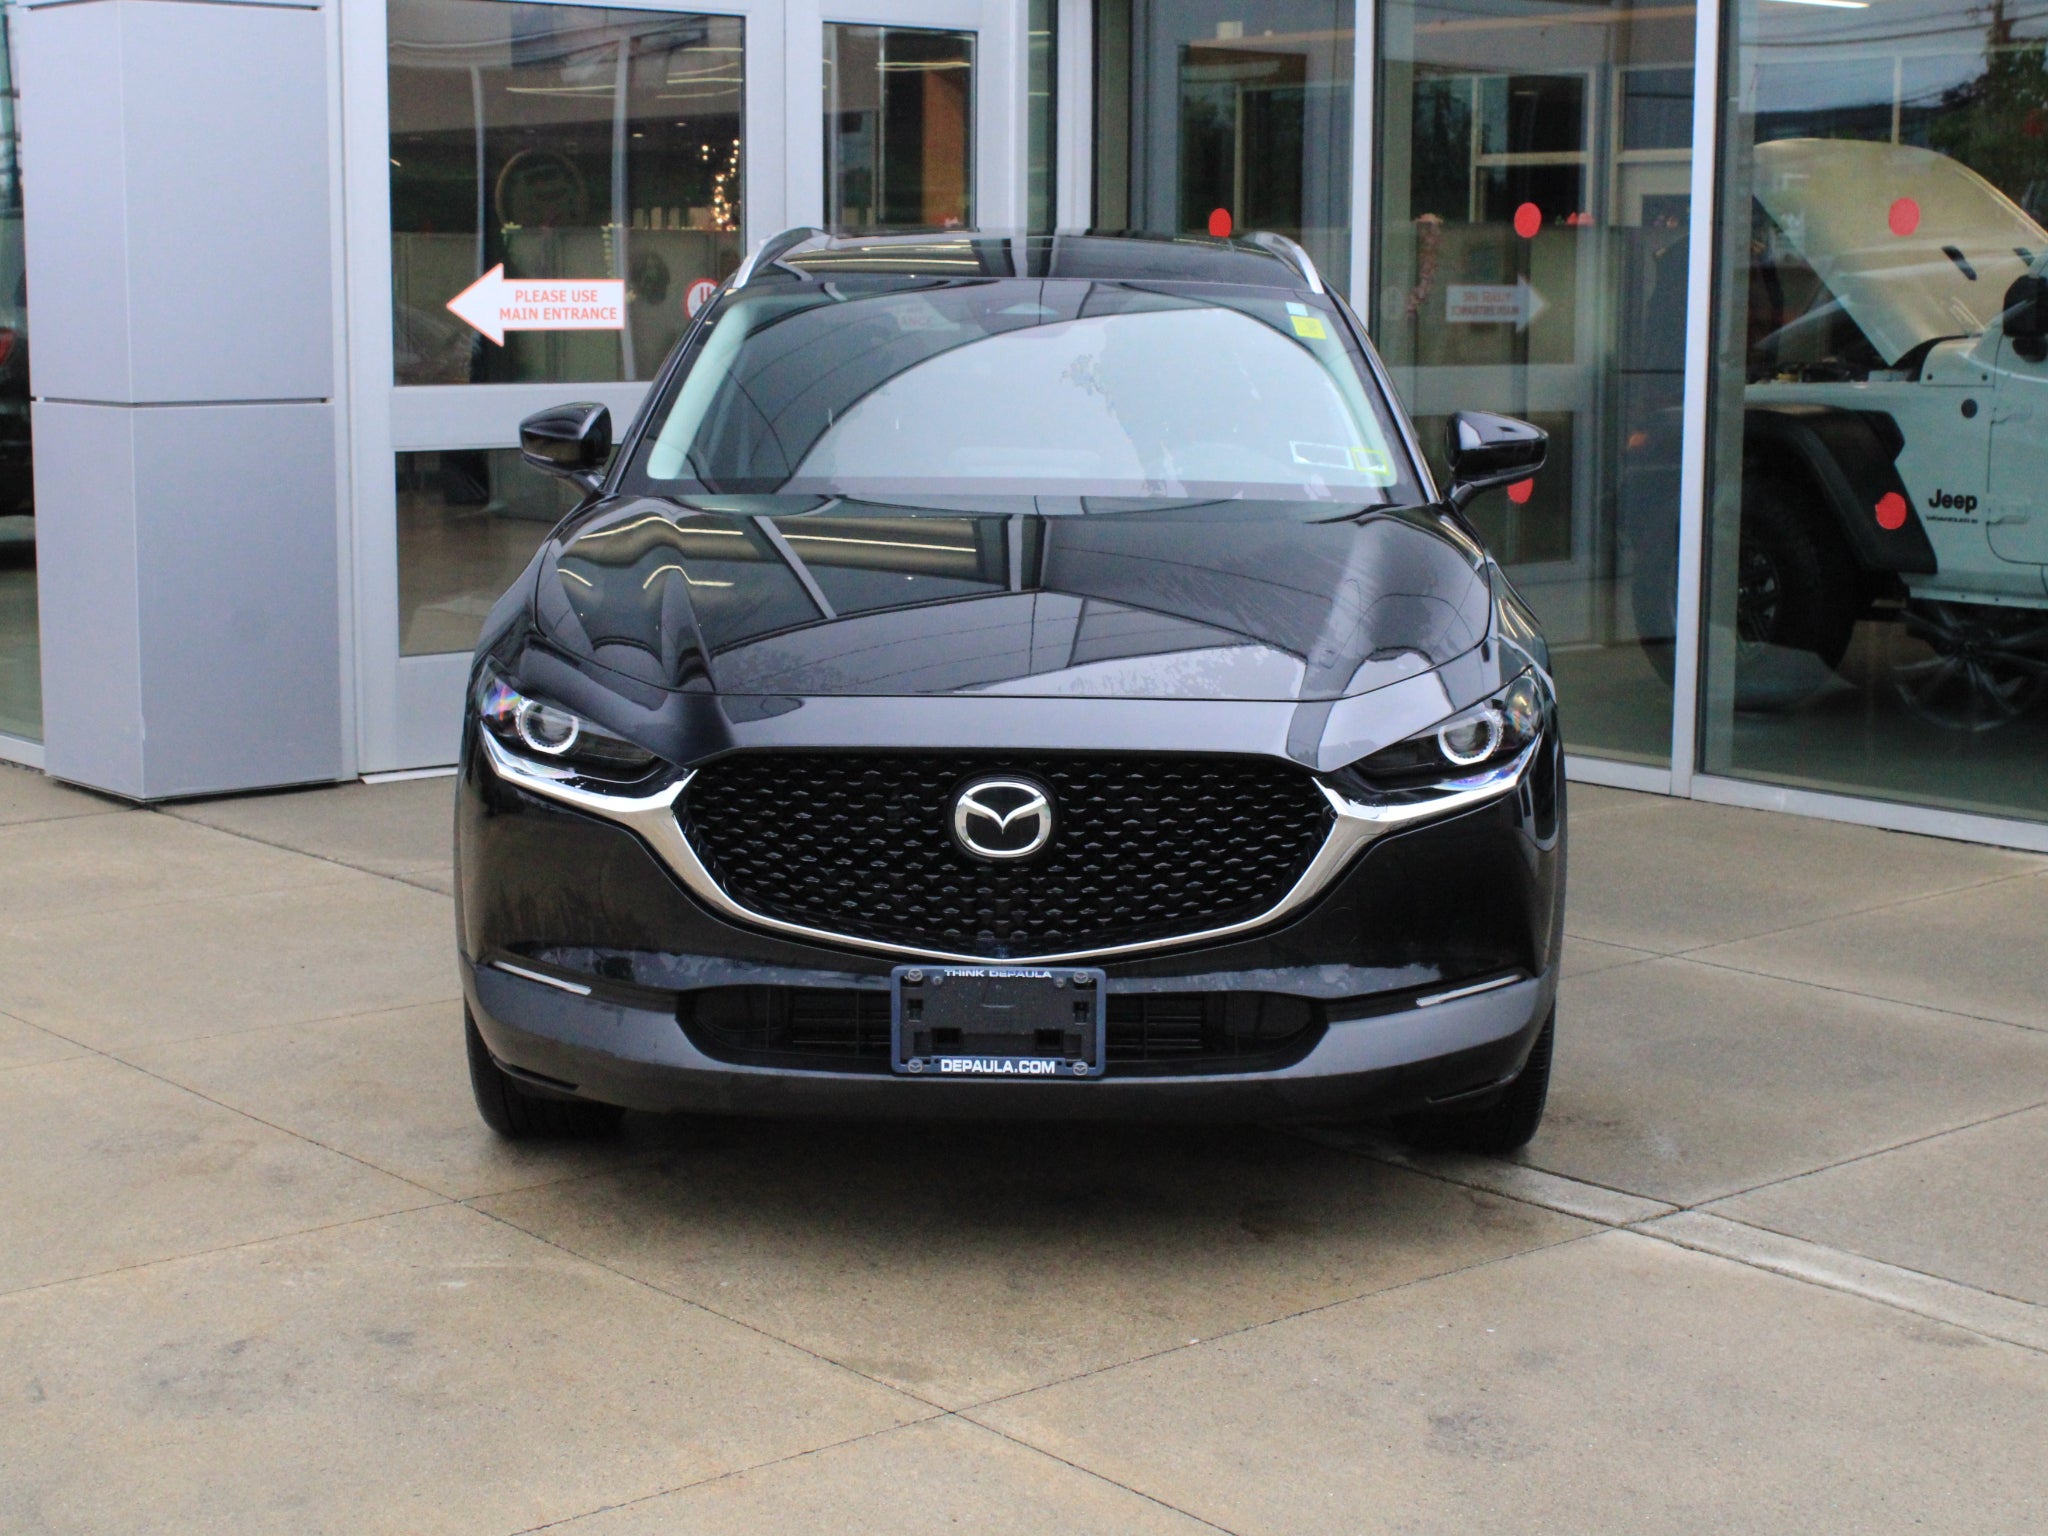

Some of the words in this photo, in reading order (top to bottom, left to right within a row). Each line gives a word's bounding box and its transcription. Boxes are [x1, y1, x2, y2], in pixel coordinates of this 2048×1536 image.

[515, 290, 566, 302] PLEASE
[572, 289, 598, 302] USE
[500, 308, 538, 320] MAIN
[543, 307, 617, 320] ENTRANCE
[1928, 489, 1978, 514] Jeep
[944, 969, 985, 977] THINK
[989, 970, 1052, 978] DEPAULA
[941, 1059, 1056, 1074] DEPAULA.COM
